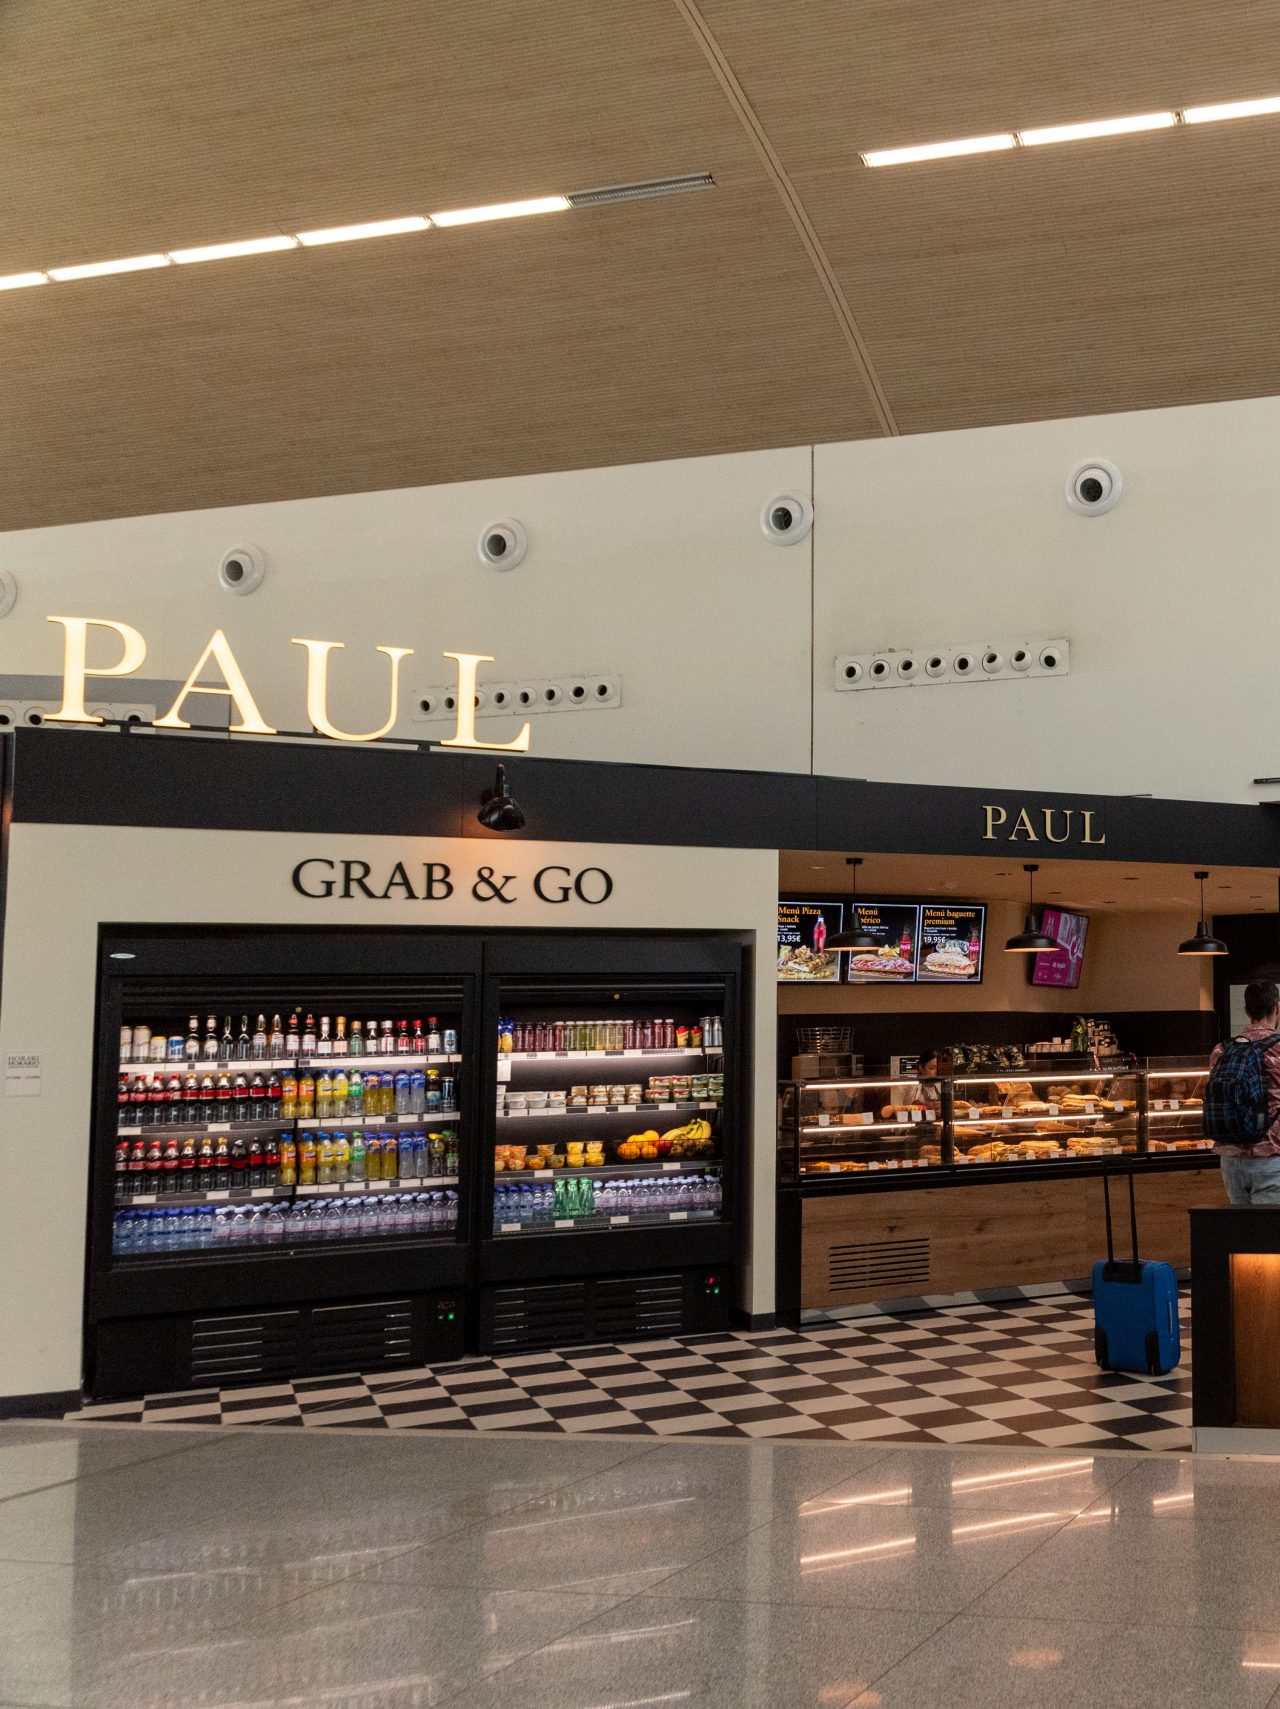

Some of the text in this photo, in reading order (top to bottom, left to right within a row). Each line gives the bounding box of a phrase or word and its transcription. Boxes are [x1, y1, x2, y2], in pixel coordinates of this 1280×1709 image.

[42, 615, 531, 752] PAUL
[981, 805, 1106, 845] PAUL
[292, 858, 614, 904] GRAB & GO
[778, 906, 821, 915] Menú Pizza
[857, 907, 878, 915] Menú
[924, 909, 976, 918] Menú baguette
[777, 914, 800, 923] Snack
[924, 917, 955, 926] premium
[777, 935, 801, 943] 13,95€
[924, 936, 946, 944] 19,95€
